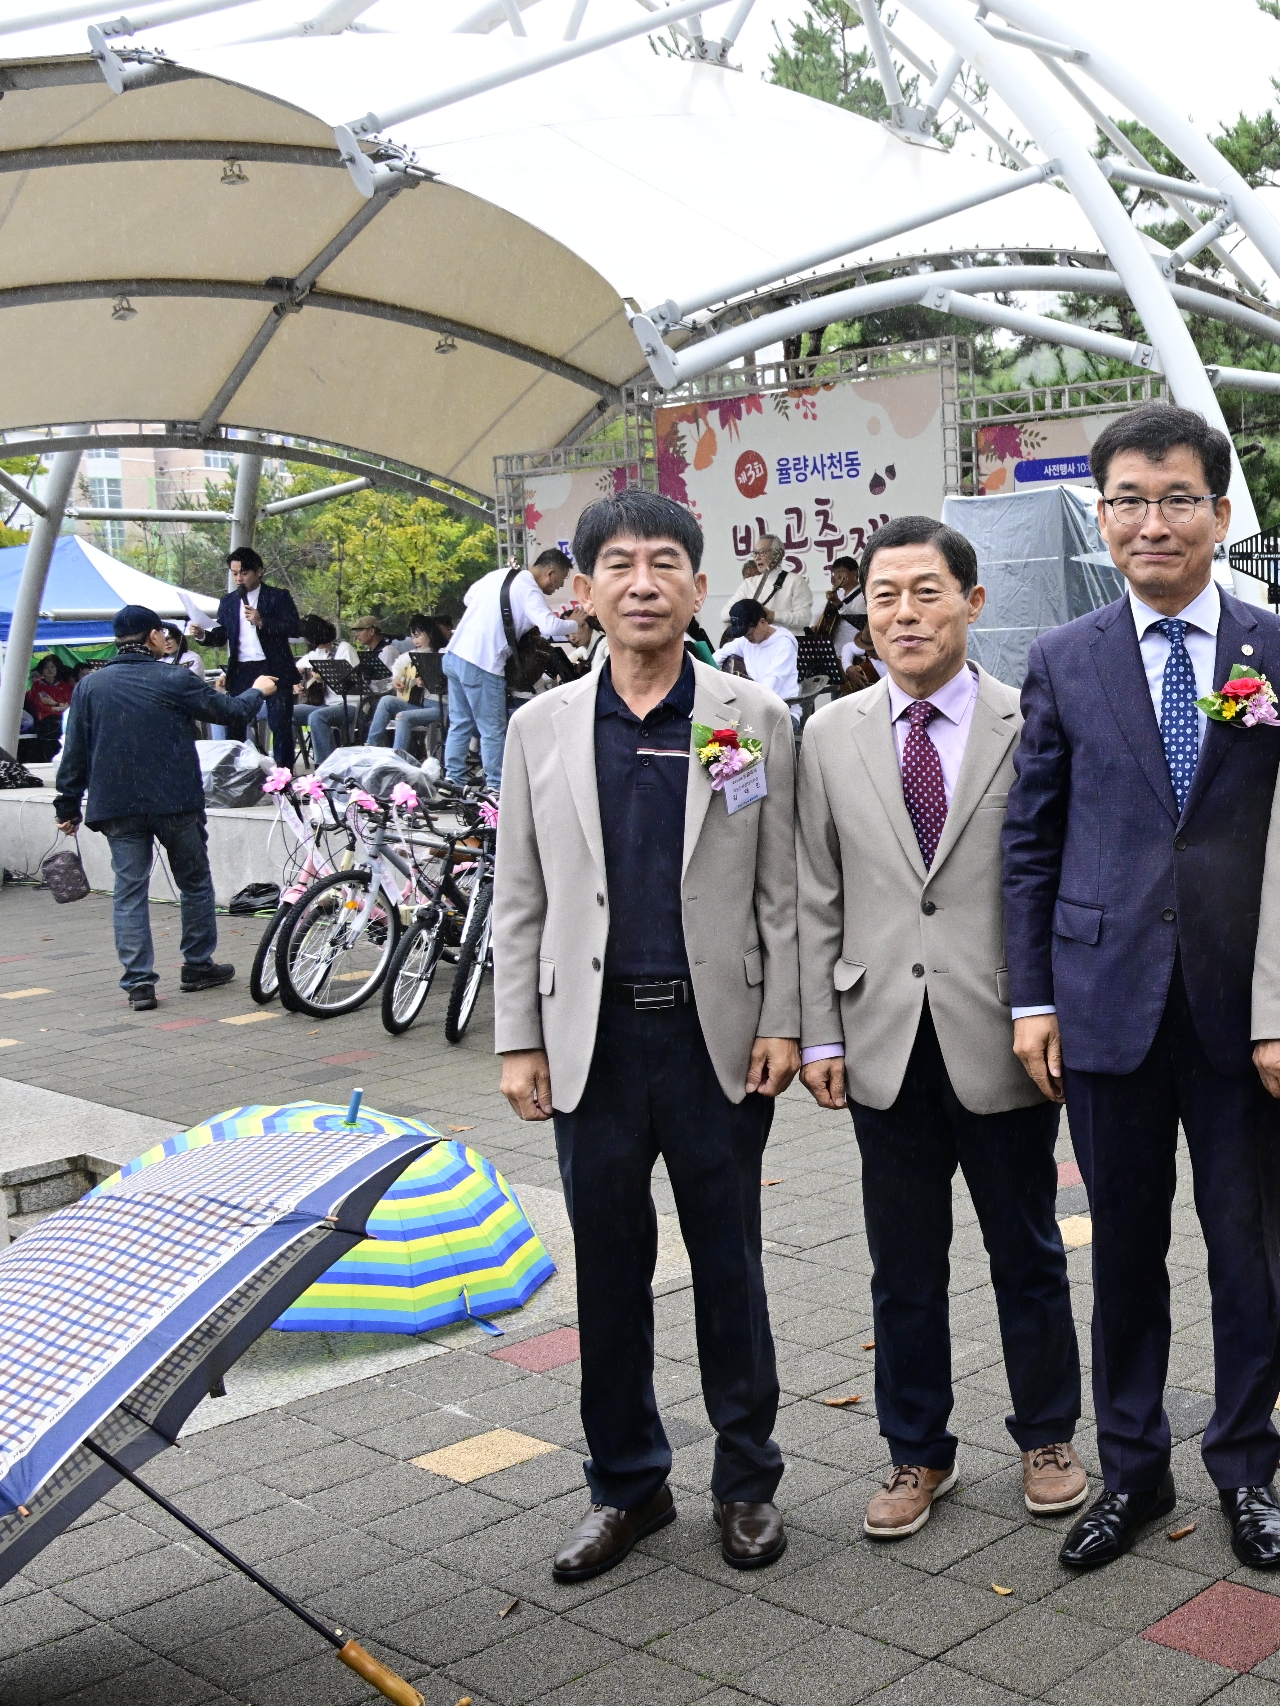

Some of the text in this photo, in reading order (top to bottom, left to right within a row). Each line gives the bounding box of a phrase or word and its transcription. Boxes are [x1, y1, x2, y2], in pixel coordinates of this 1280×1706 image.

[737, 450, 862, 486] 제3회 율량사천동
[1043, 462, 1091, 477] 사전행사 10:
